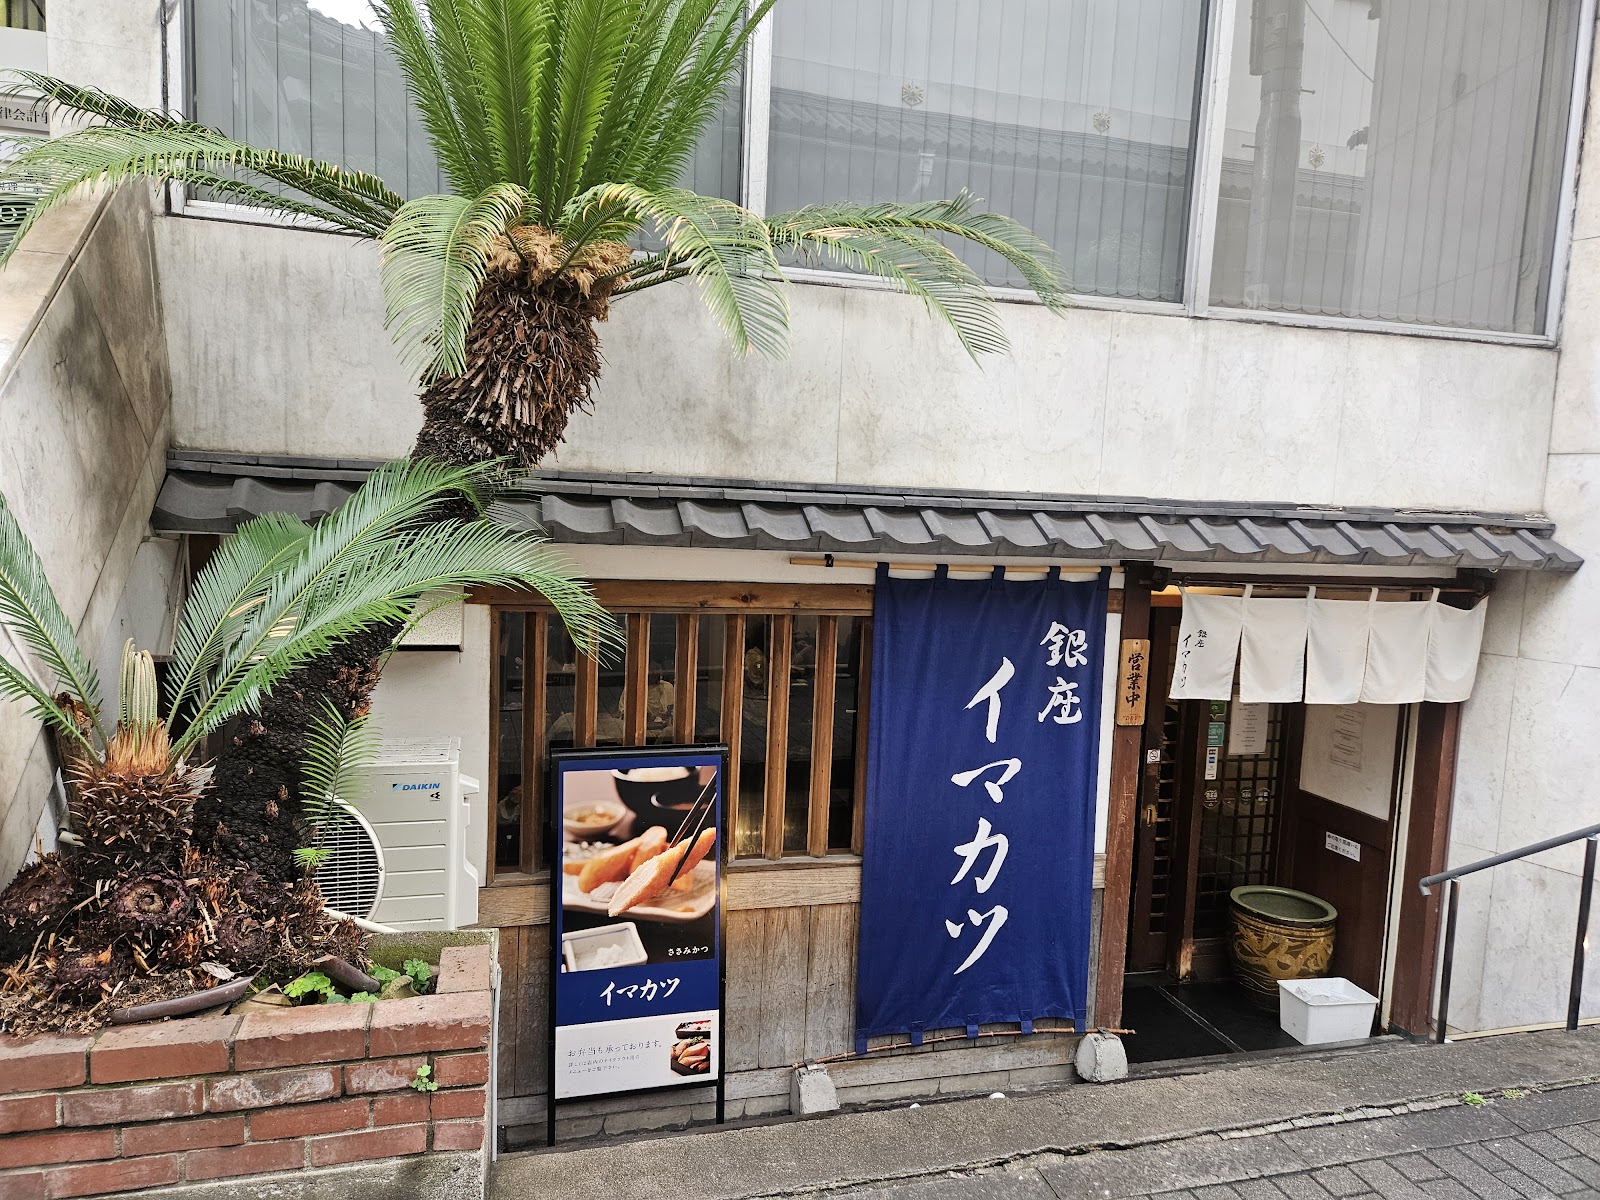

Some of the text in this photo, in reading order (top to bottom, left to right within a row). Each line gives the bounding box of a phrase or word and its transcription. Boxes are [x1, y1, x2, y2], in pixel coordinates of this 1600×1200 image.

[1194, 629, 1208, 648] 銀座
[1038, 620, 1089, 726] 銀座
[1180, 634, 1192, 688] イマカツ
[1125, 652, 1145, 709] 営業中
[402, 783, 441, 791] DAIKIN
[944, 656, 1023, 976] イマカツ
[667, 945, 709, 957] ささみかつ
[599, 977, 680, 1007] イマカツ
[567, 1039, 662, 1057] お弁当も承っております。
